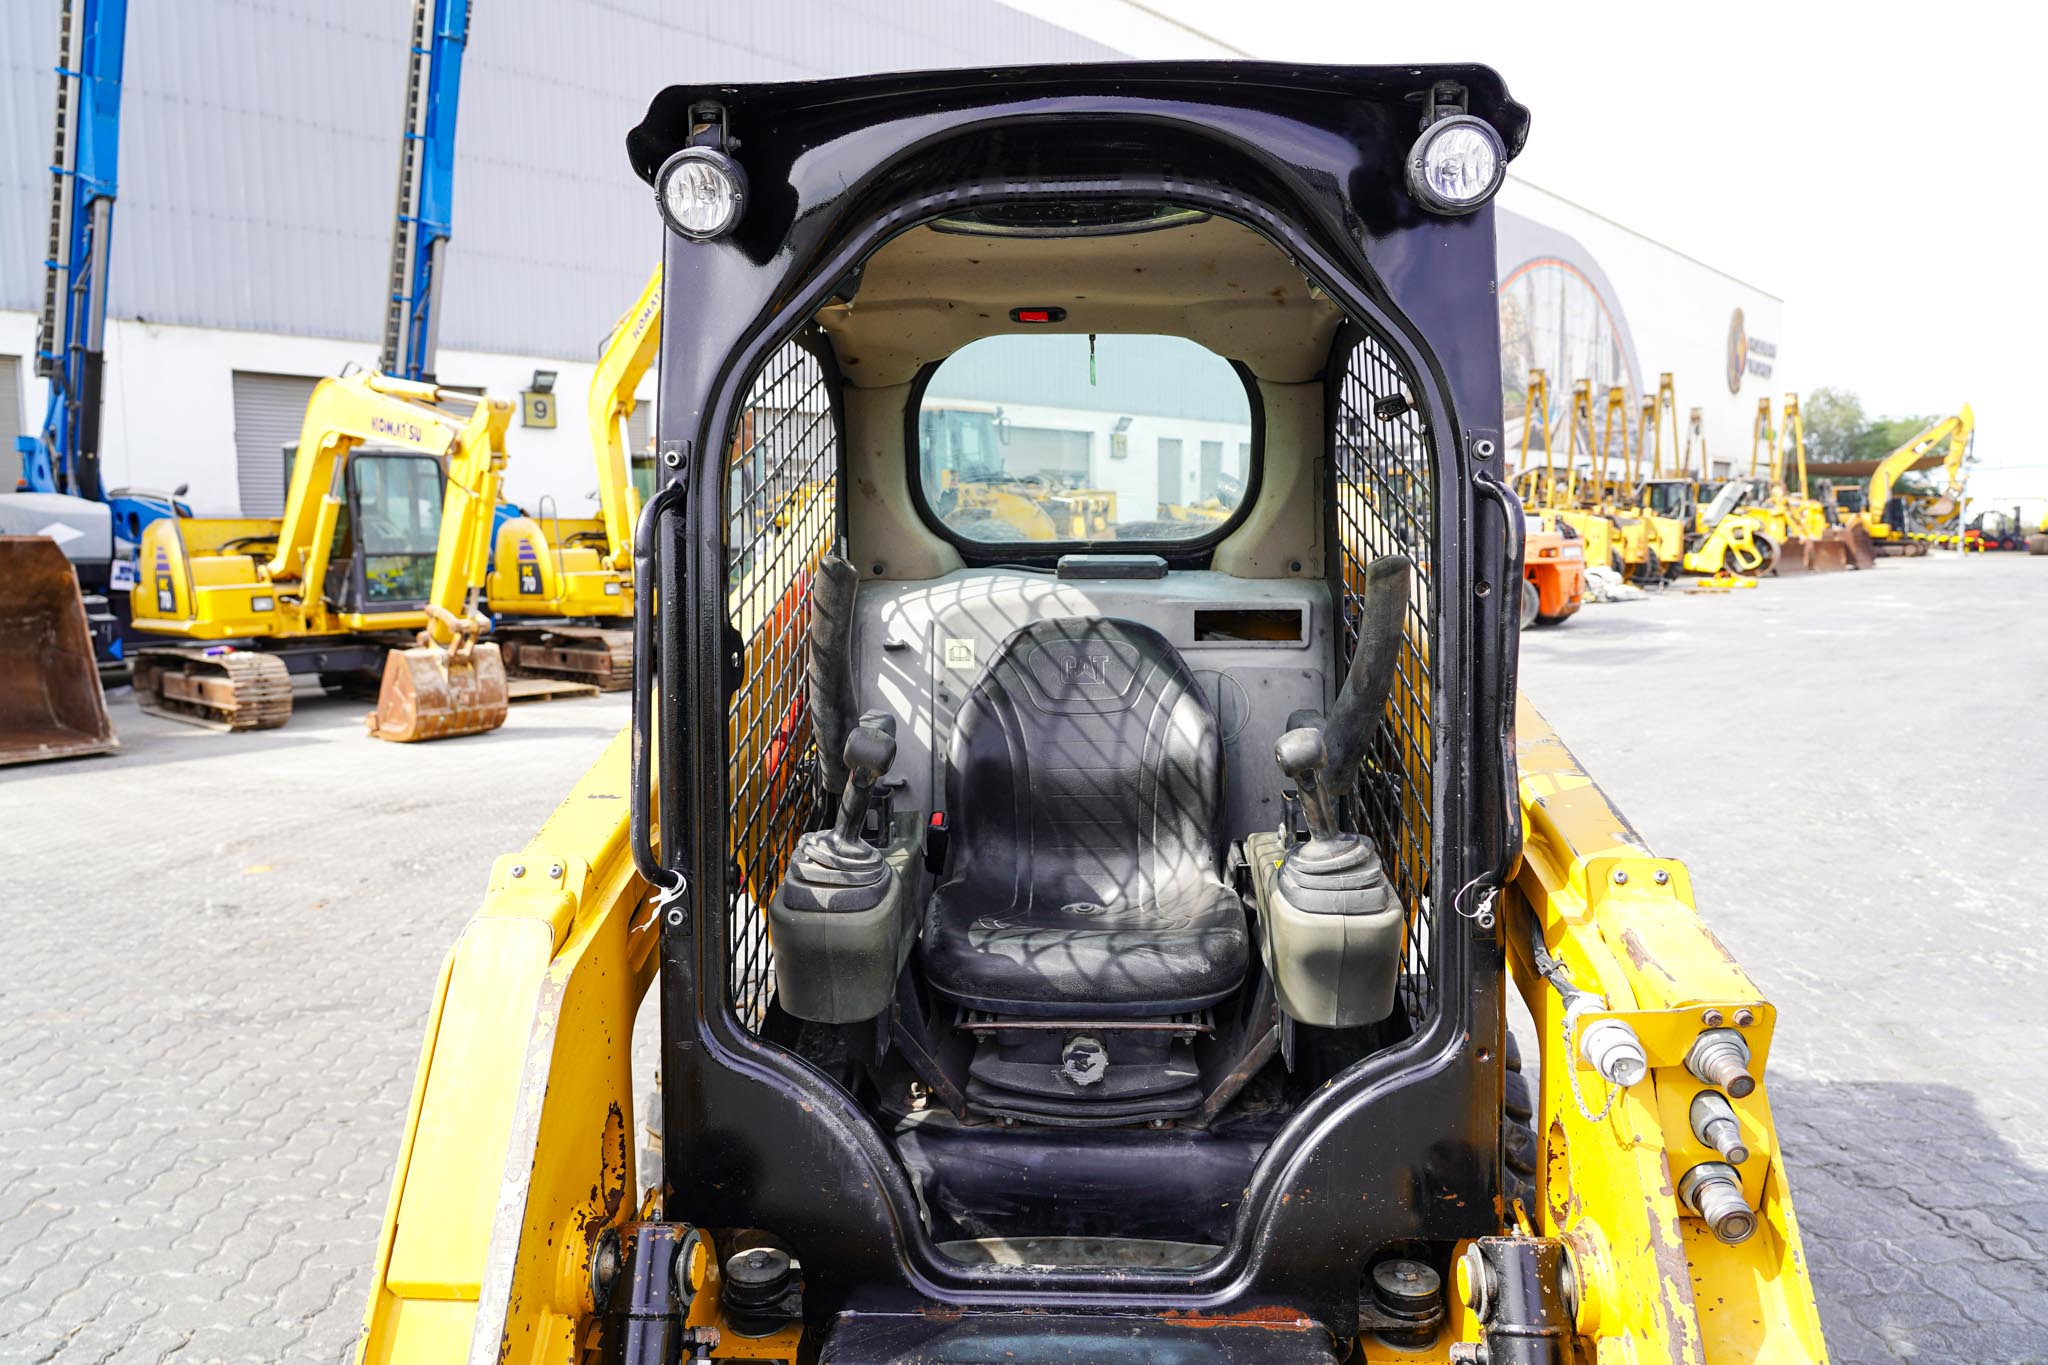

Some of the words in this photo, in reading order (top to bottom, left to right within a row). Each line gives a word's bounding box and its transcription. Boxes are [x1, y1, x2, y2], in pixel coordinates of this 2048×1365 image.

[534, 400, 547, 419] 9
[371, 416, 422, 443] KOMATSU
[522, 576, 537, 592] 70
[1060, 656, 1109, 685] CAT
